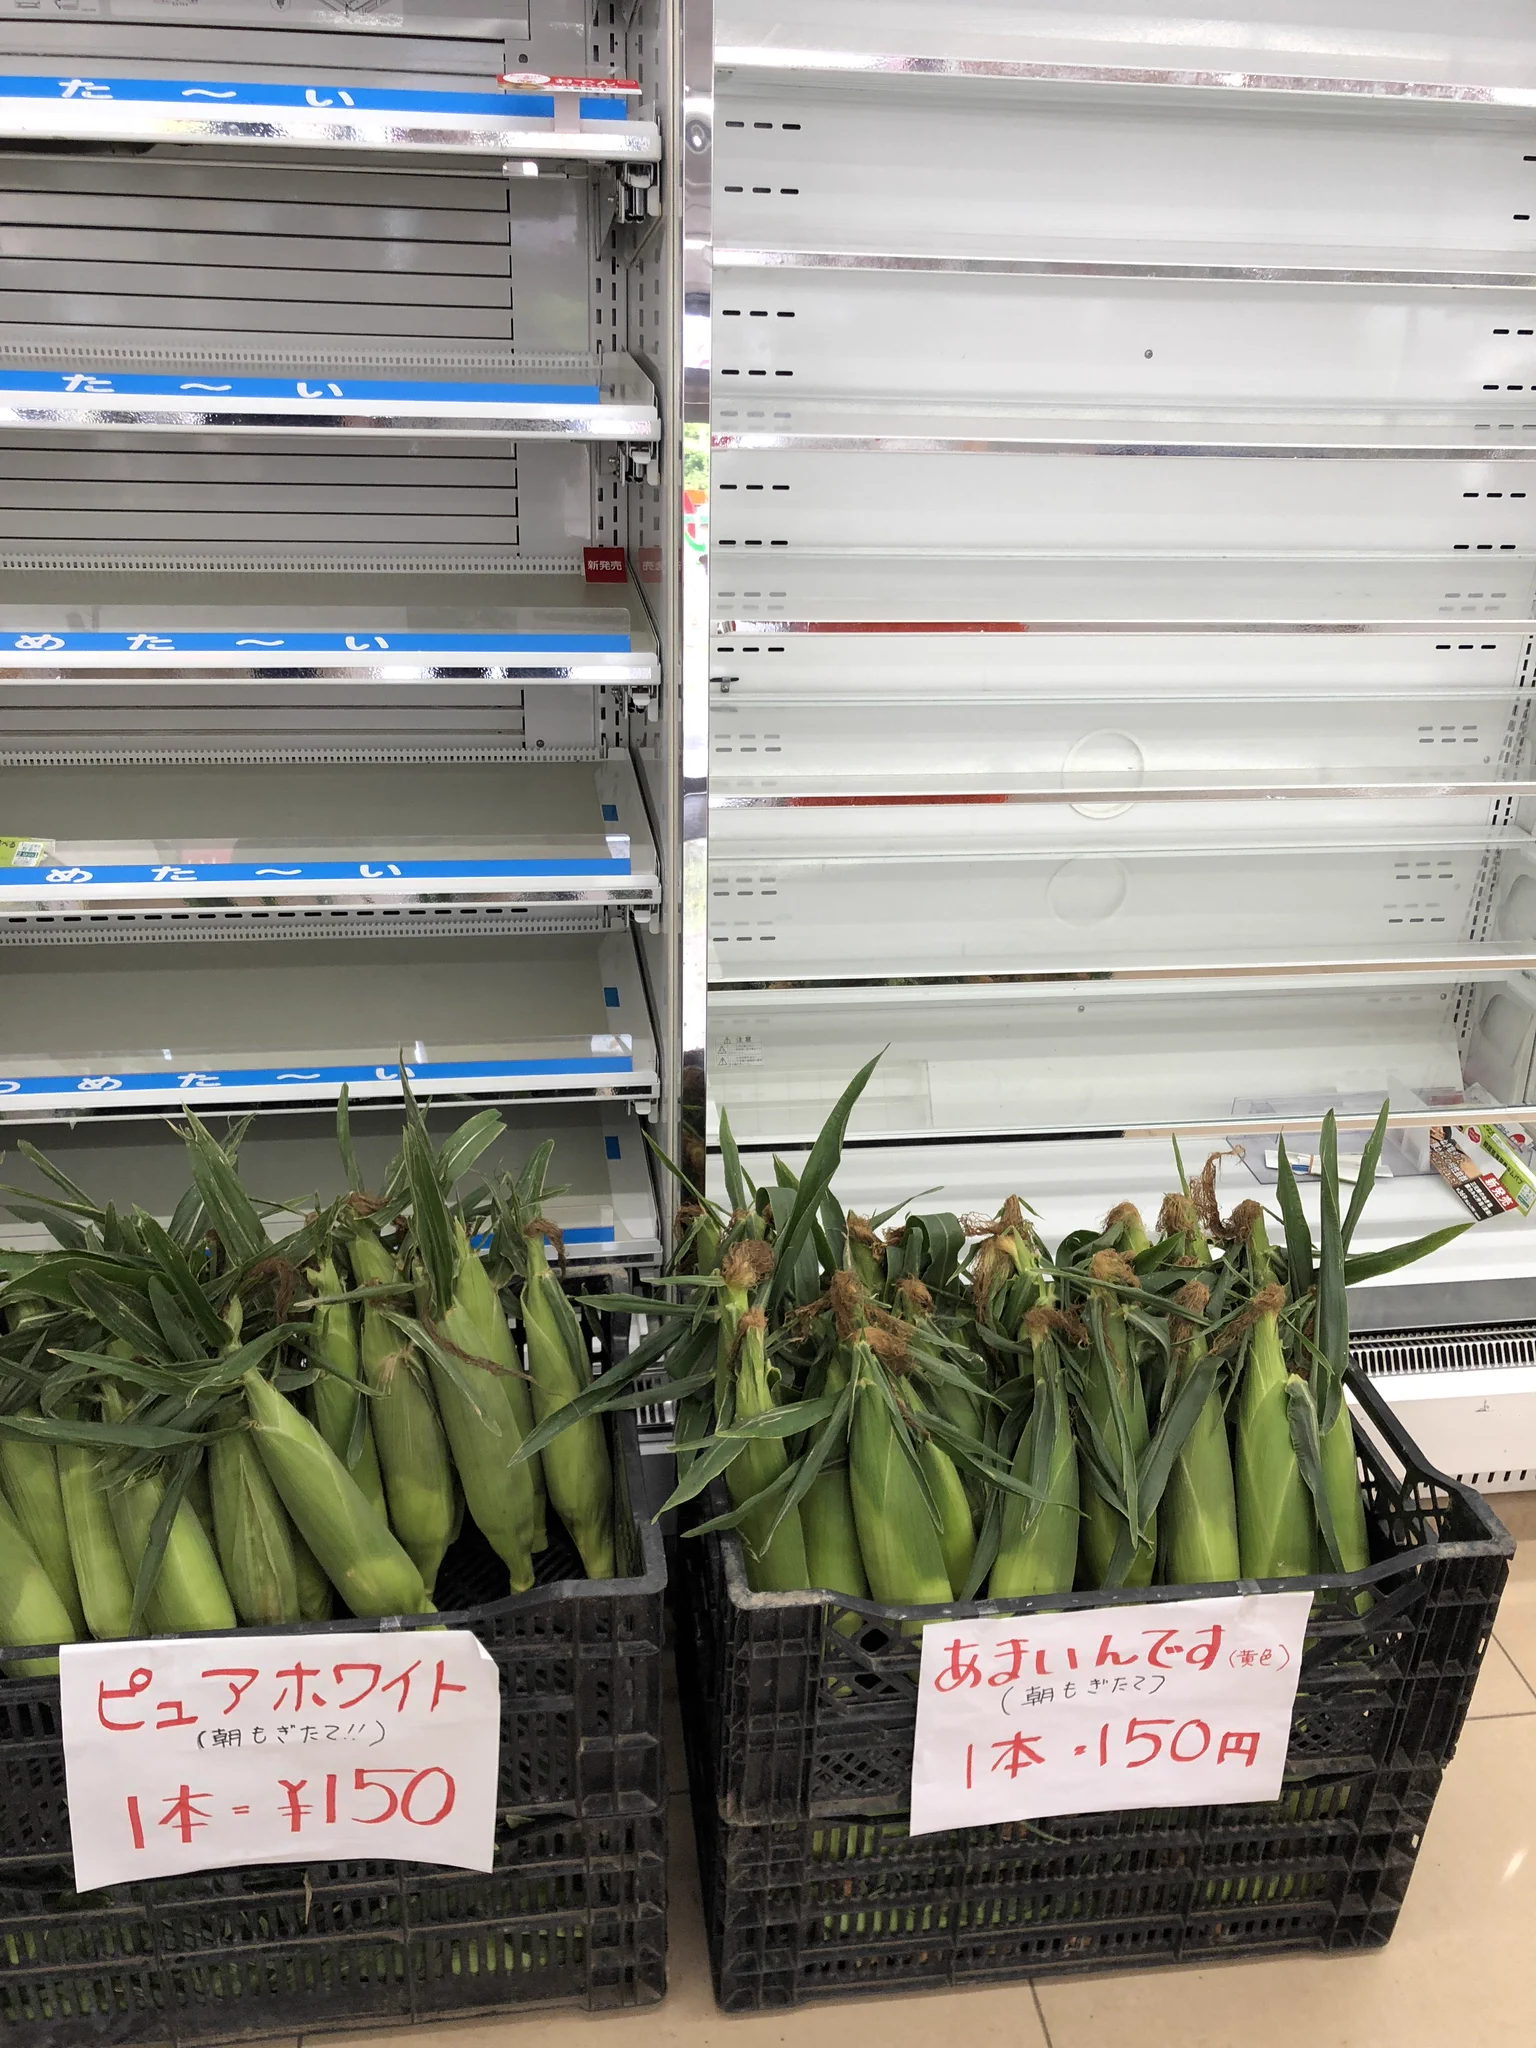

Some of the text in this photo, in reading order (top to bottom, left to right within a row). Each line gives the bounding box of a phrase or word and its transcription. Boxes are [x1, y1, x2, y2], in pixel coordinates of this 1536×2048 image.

[587, 560, 623, 571] 新発売
[1484, 1177, 1514, 1207] 新発売
[97, 1660, 467, 1732] ピュアホワイト
